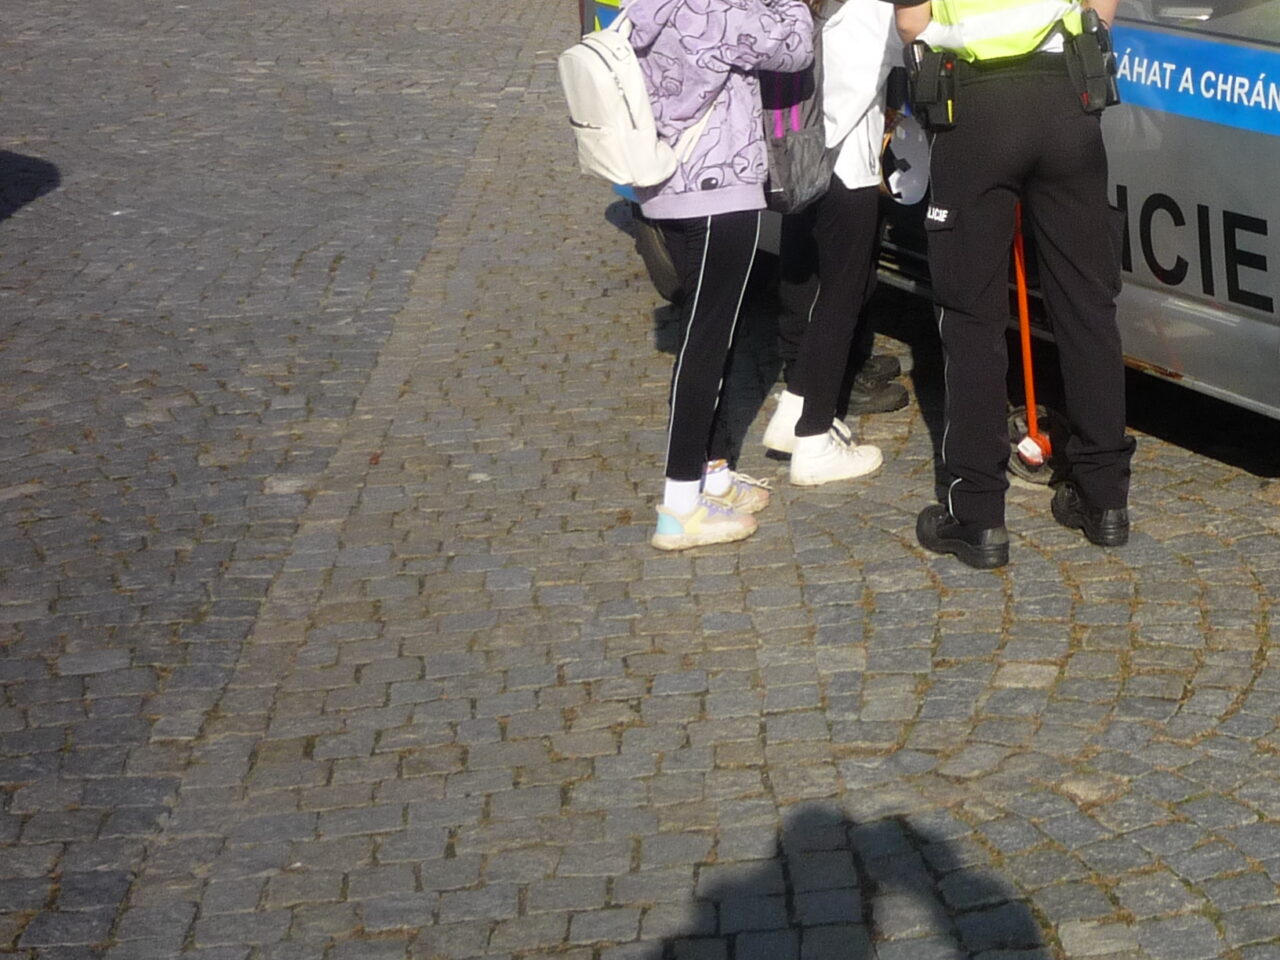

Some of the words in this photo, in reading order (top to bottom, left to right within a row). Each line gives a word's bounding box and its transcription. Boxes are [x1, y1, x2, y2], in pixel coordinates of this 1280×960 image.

[1114, 48, 1176, 89] ÁHAT
[1178, 68, 1194, 95] A
[927, 205, 948, 222] LICIE
[1116, 184, 1274, 313] ICIE
